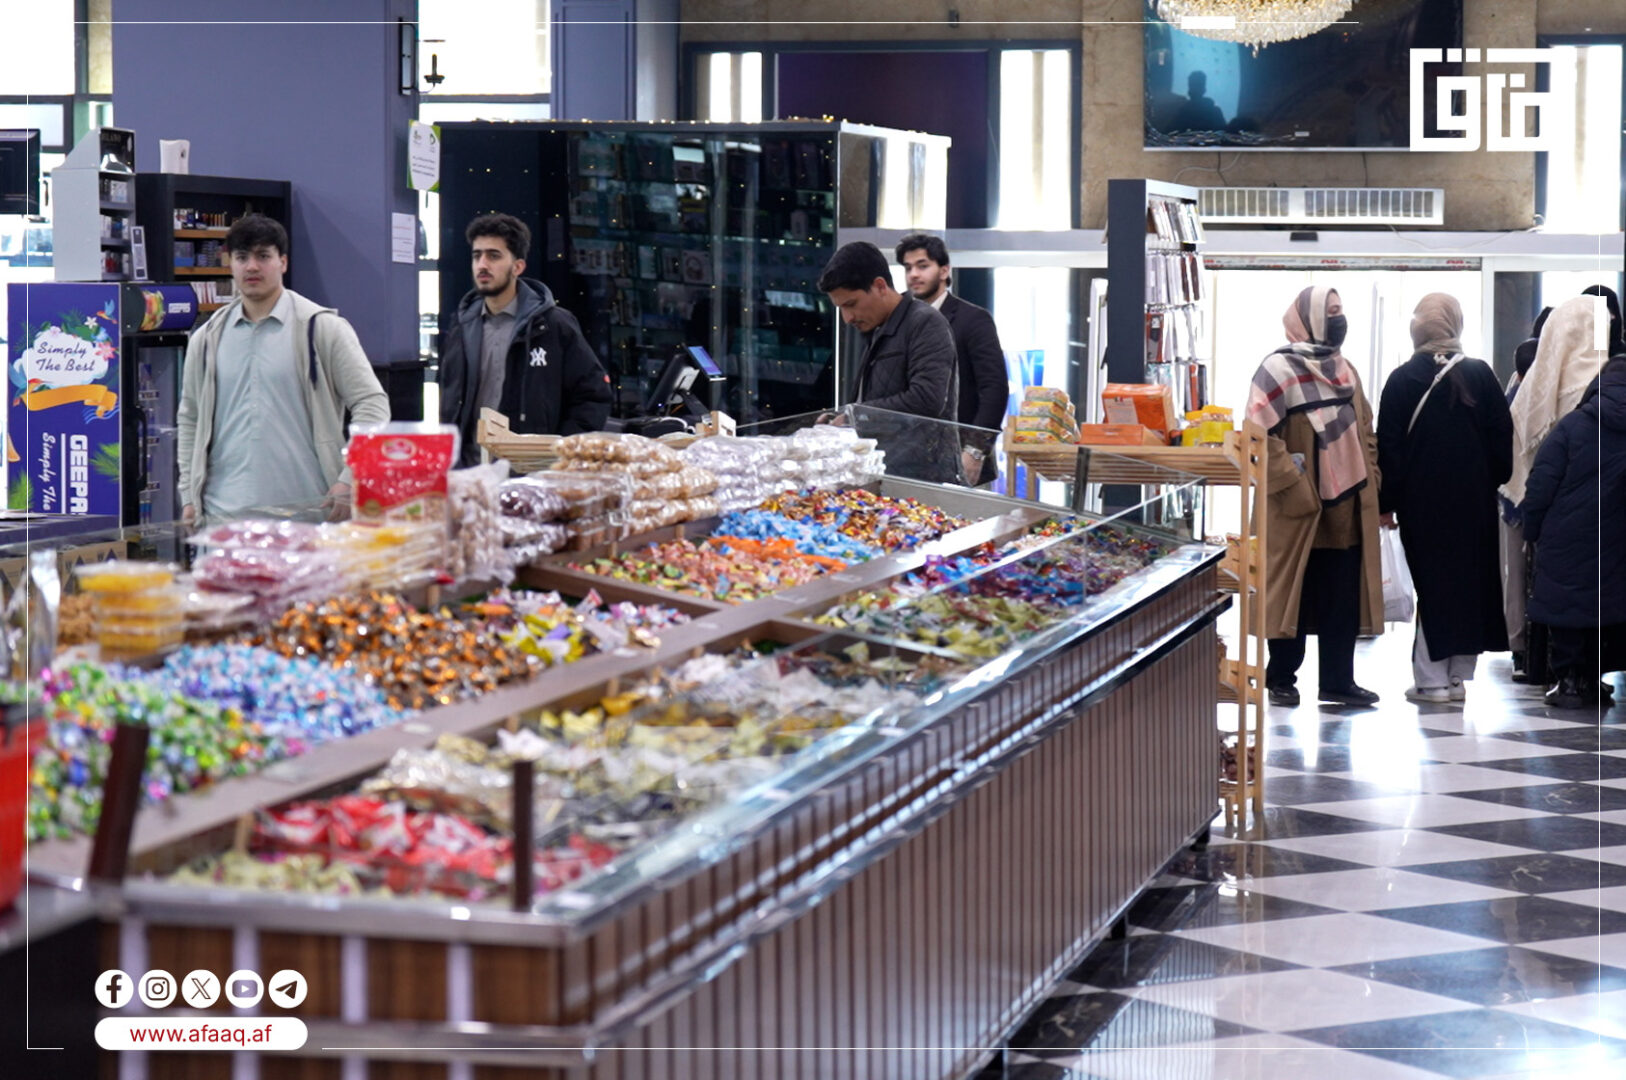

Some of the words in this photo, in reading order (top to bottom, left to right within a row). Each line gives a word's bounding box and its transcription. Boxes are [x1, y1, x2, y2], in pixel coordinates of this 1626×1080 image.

[36, 358, 61, 371] The
[65, 358, 95, 371] Best
[37, 341, 87, 359] Simply
[38, 432, 56, 482] Simply
[70, 434, 88, 515] GEEPA
